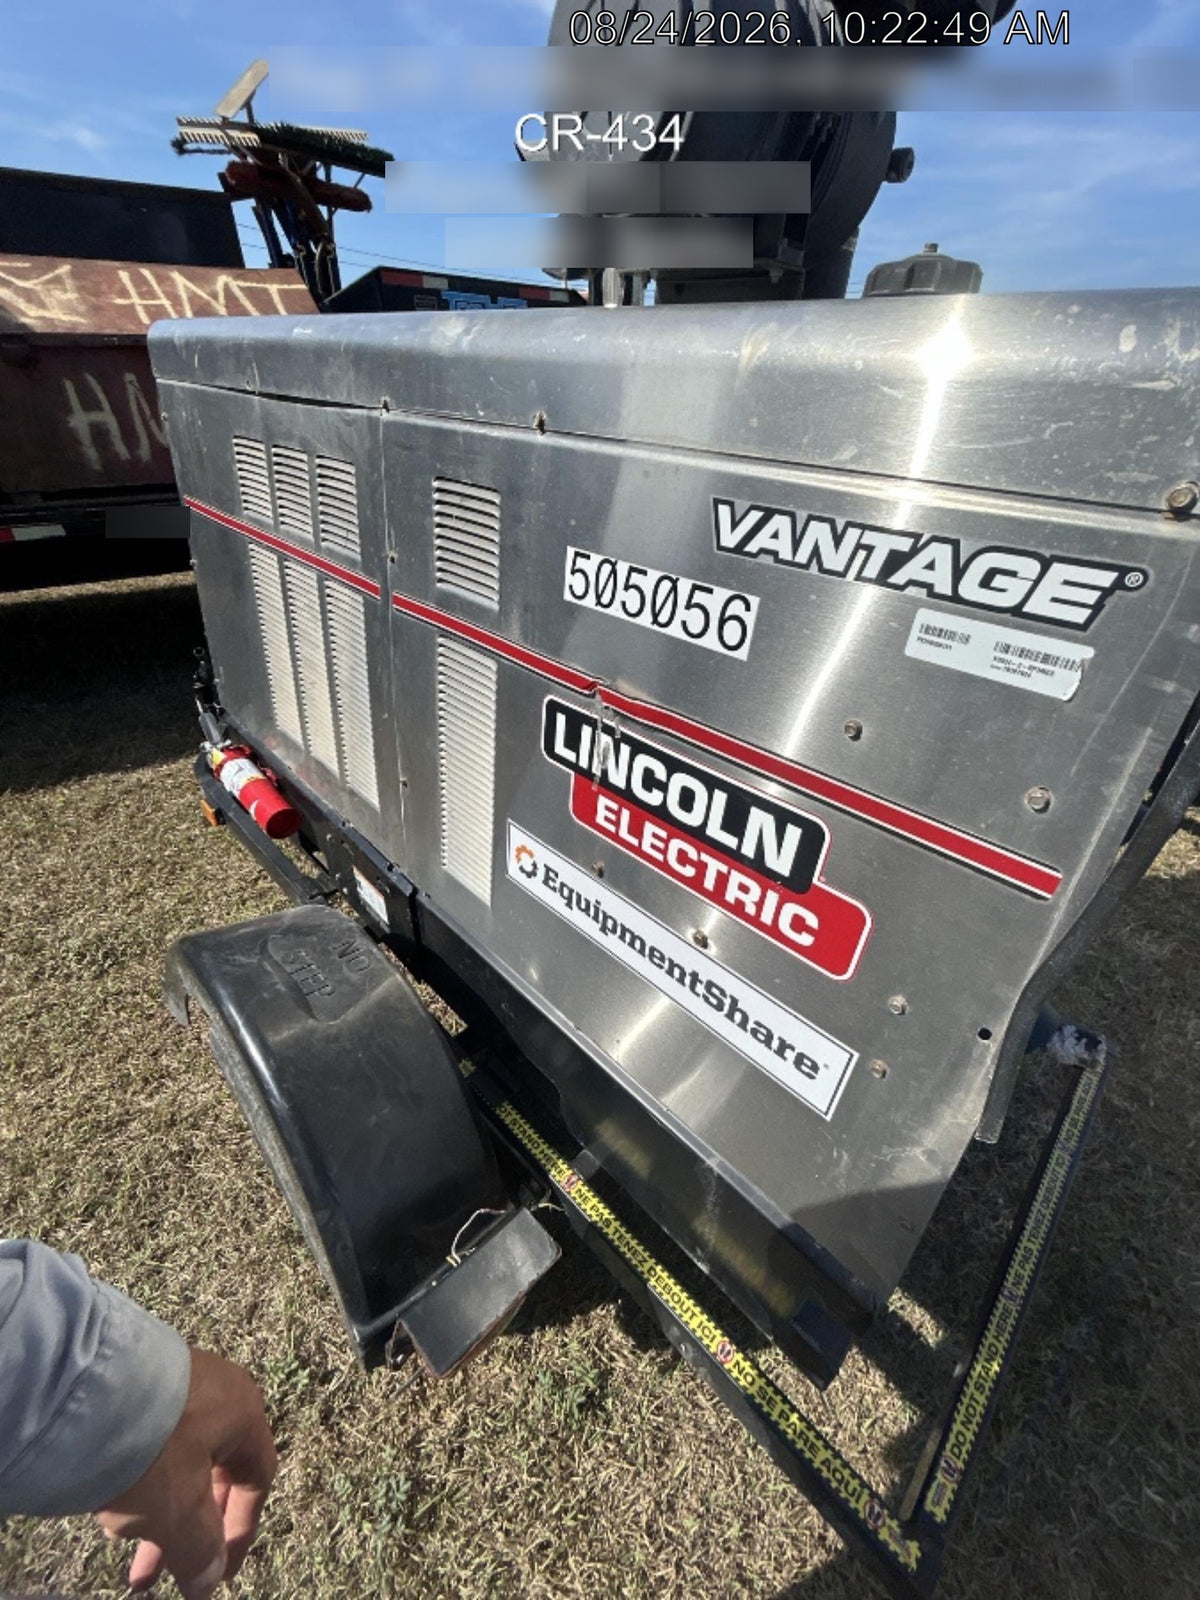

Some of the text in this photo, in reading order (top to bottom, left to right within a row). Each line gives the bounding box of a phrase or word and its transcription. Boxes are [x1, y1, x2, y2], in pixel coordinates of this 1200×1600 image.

[111, 267, 308, 325] HMT
[566, 550, 754, 653] 505056
[552, 712, 804, 880] LINCOLN
[594, 793, 820, 948] ELECTRIC
[332, 940, 373, 974] NO
[540, 864, 822, 1082] EquipmentShare
[646, 1265, 699, 1321] DEBOUT
[697, 1318, 717, 1344] ICI
[731, 1359, 757, 1389] NO
[756, 1385, 778, 1412] SE
[776, 1409, 820, 1460] PARE
[950, 1304, 1014, 1461] DO NOT STAND HERE
